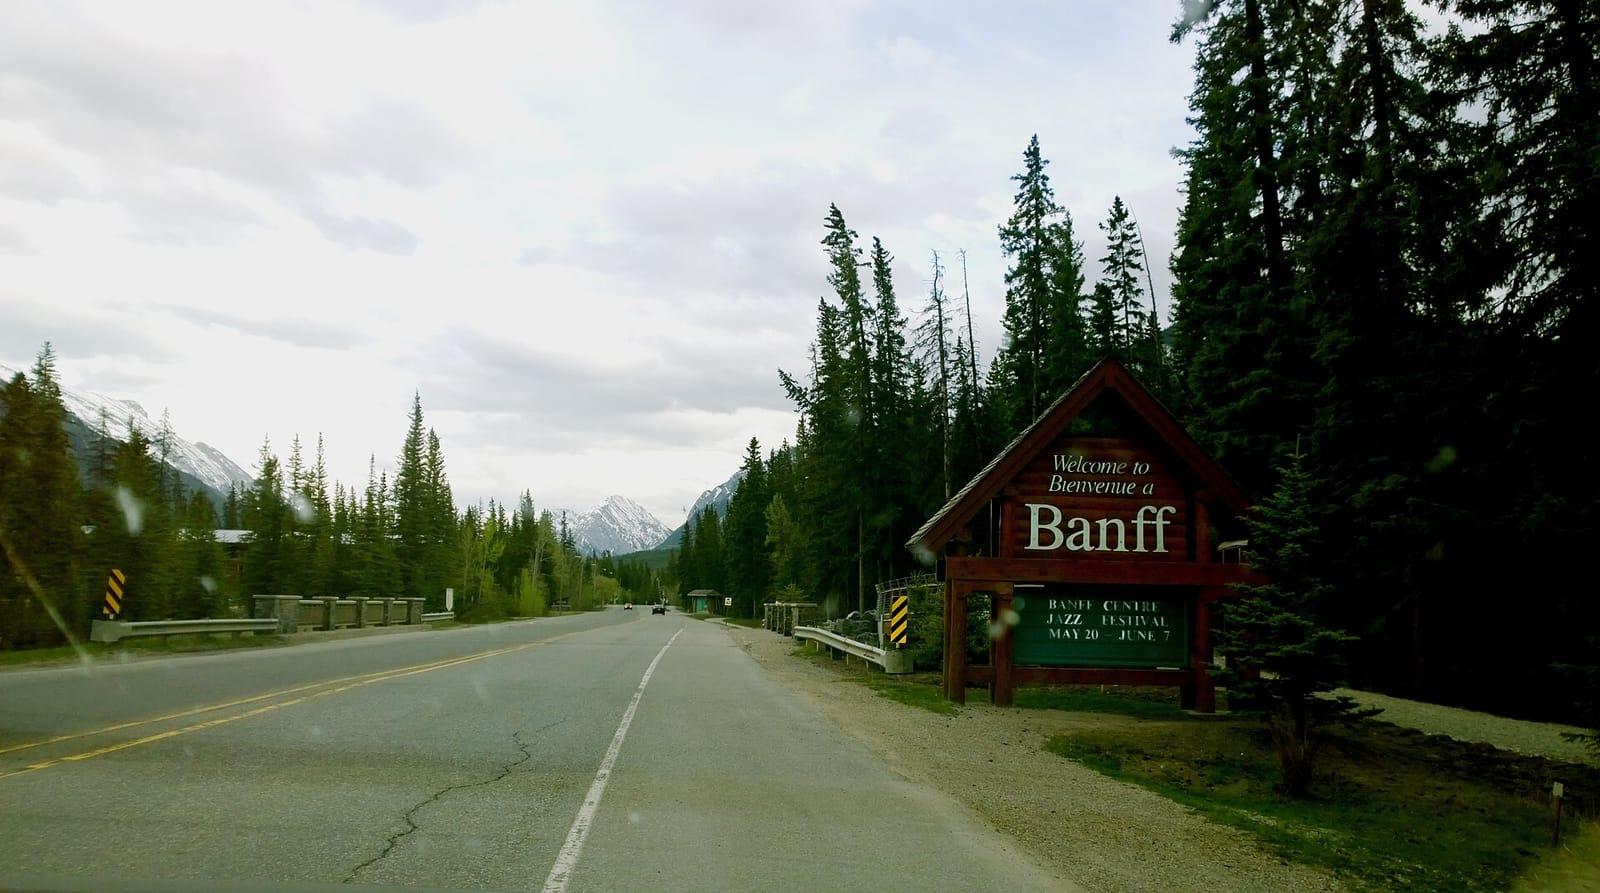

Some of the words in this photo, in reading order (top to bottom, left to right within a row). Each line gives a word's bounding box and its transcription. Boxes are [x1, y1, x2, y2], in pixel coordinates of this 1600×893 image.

[1053, 454, 1128, 475] Welcome
[1132, 461, 1150, 475] to
[1048, 475, 1136, 495] Bienvenue
[1024, 503, 1177, 553] Banff
[1049, 599, 1093, 610] BANFF
[1103, 600, 1161, 612] CENTRE
[1046, 613, 1083, 625] JAZZ
[1102, 615, 1168, 627] FESTIVAL
[1049, 628, 1080, 640] MAY
[1085, 629, 1099, 640] 20
[1118, 630, 1156, 641] JUNE
[1163, 630, 1171, 641] 7
